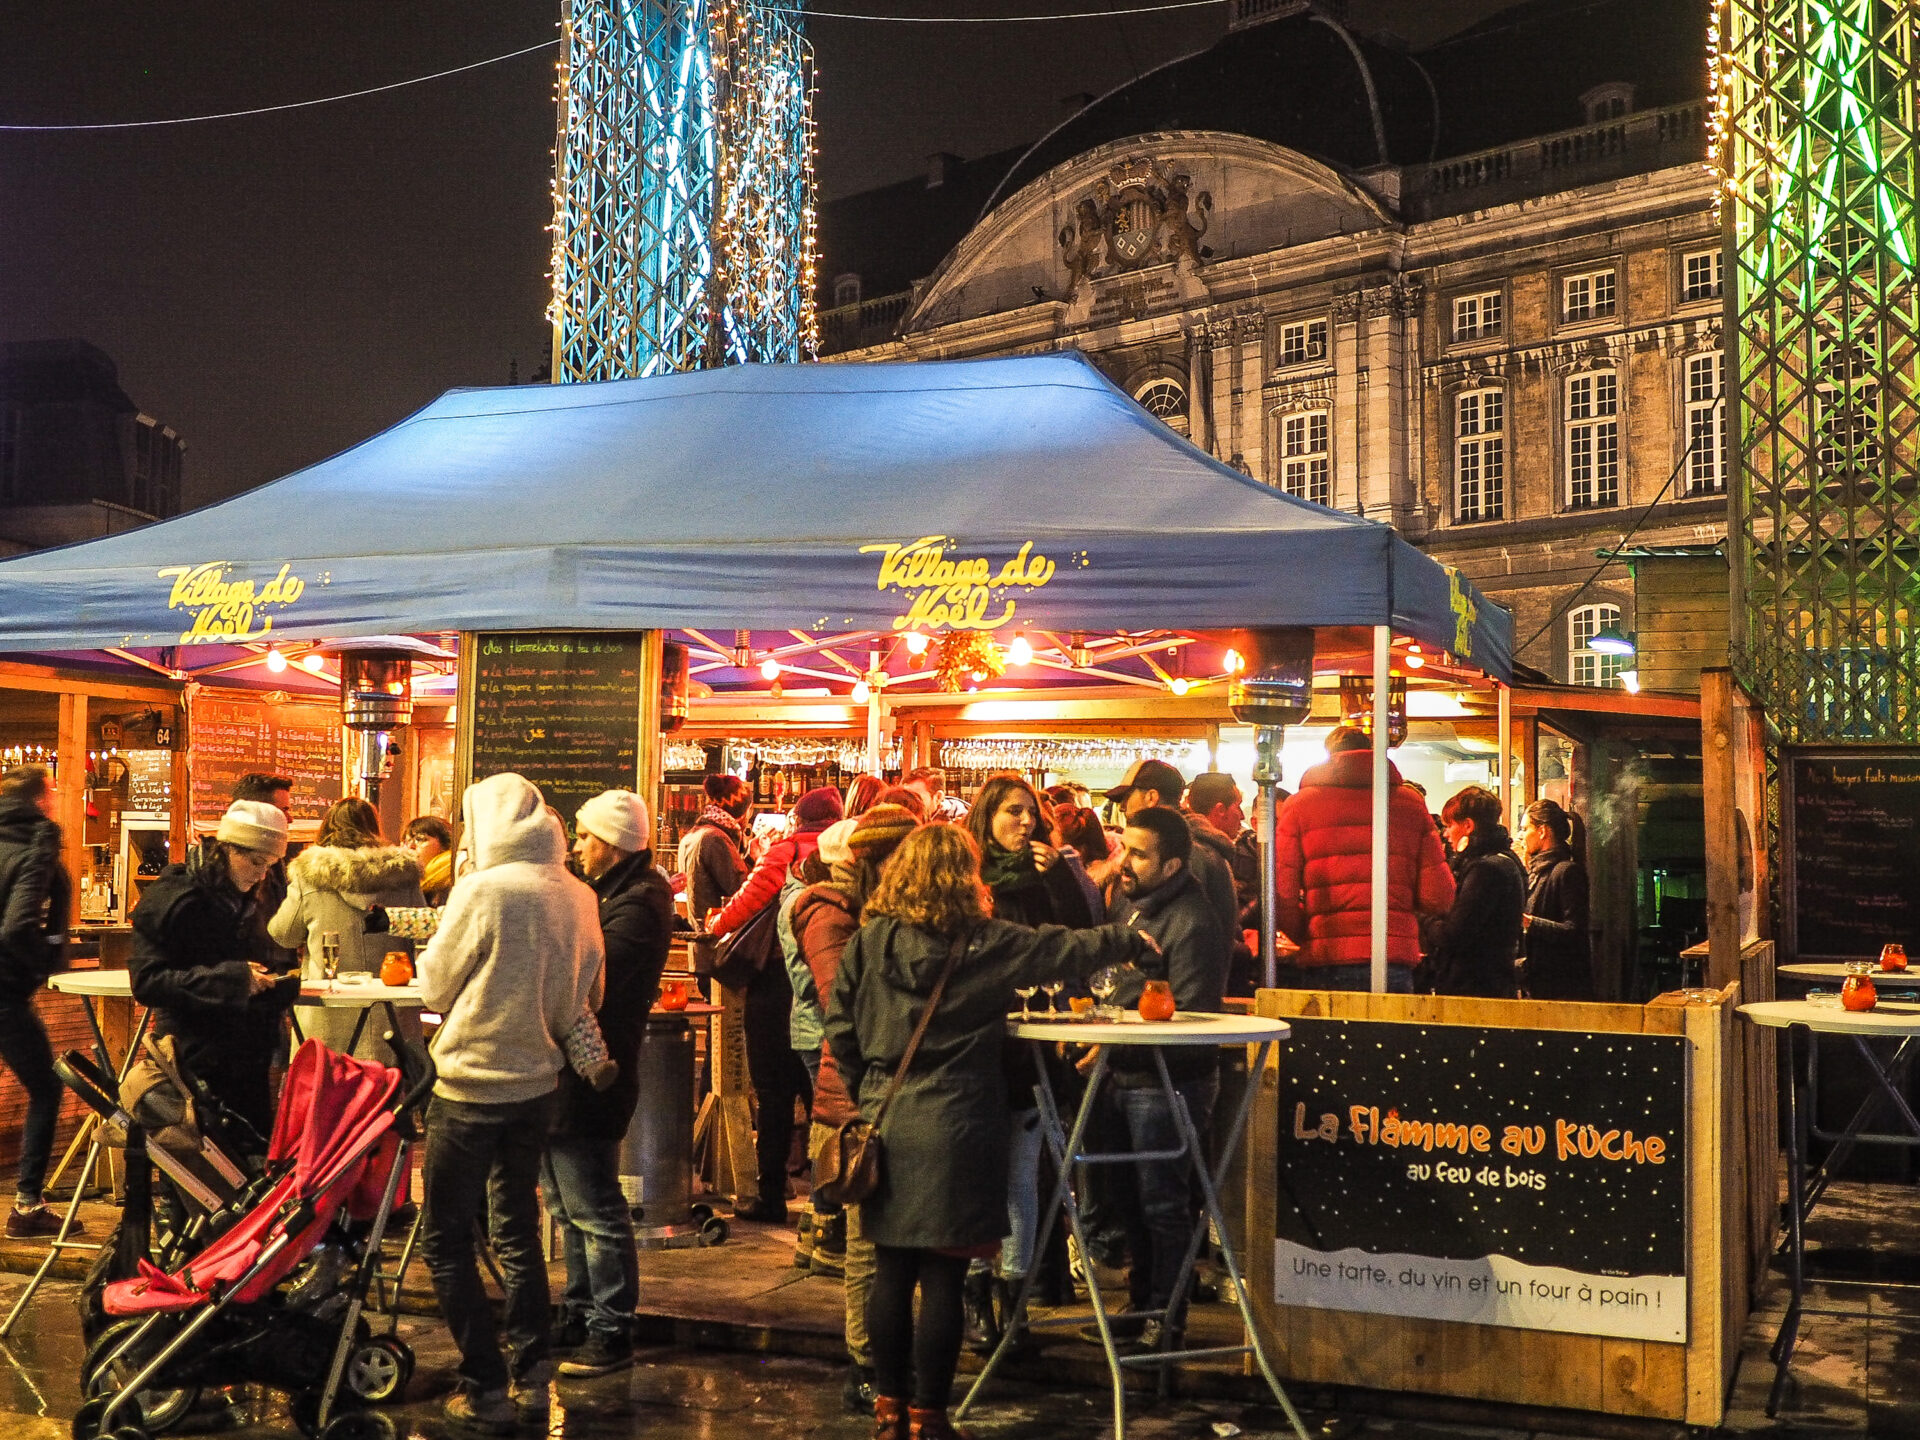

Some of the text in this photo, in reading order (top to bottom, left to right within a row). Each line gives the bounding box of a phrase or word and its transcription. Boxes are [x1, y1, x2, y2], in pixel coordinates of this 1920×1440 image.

[157, 561, 305, 619] Village de
[858, 535, 1056, 604] Village de
[179, 603, 273, 645] Noël
[892, 585, 1016, 630] Noël
[157, 729, 170, 744] 64
[1294, 1102, 1339, 1143] La
[1501, 1119, 1546, 1155] au
[1406, 1161, 1547, 1191] au feu de bois
[1293, 1257, 1333, 1279] Une
[1337, 1261, 1393, 1287] tarte,
[1399, 1266, 1426, 1287] du
[1431, 1268, 1462, 1290] vin
[1467, 1274, 1490, 1293] et
[1496, 1279, 1522, 1296] un
[1529, 1277, 1572, 1301] four
[1577, 1284, 1593, 1302] à
[1600, 1288, 1648, 1307] pain
